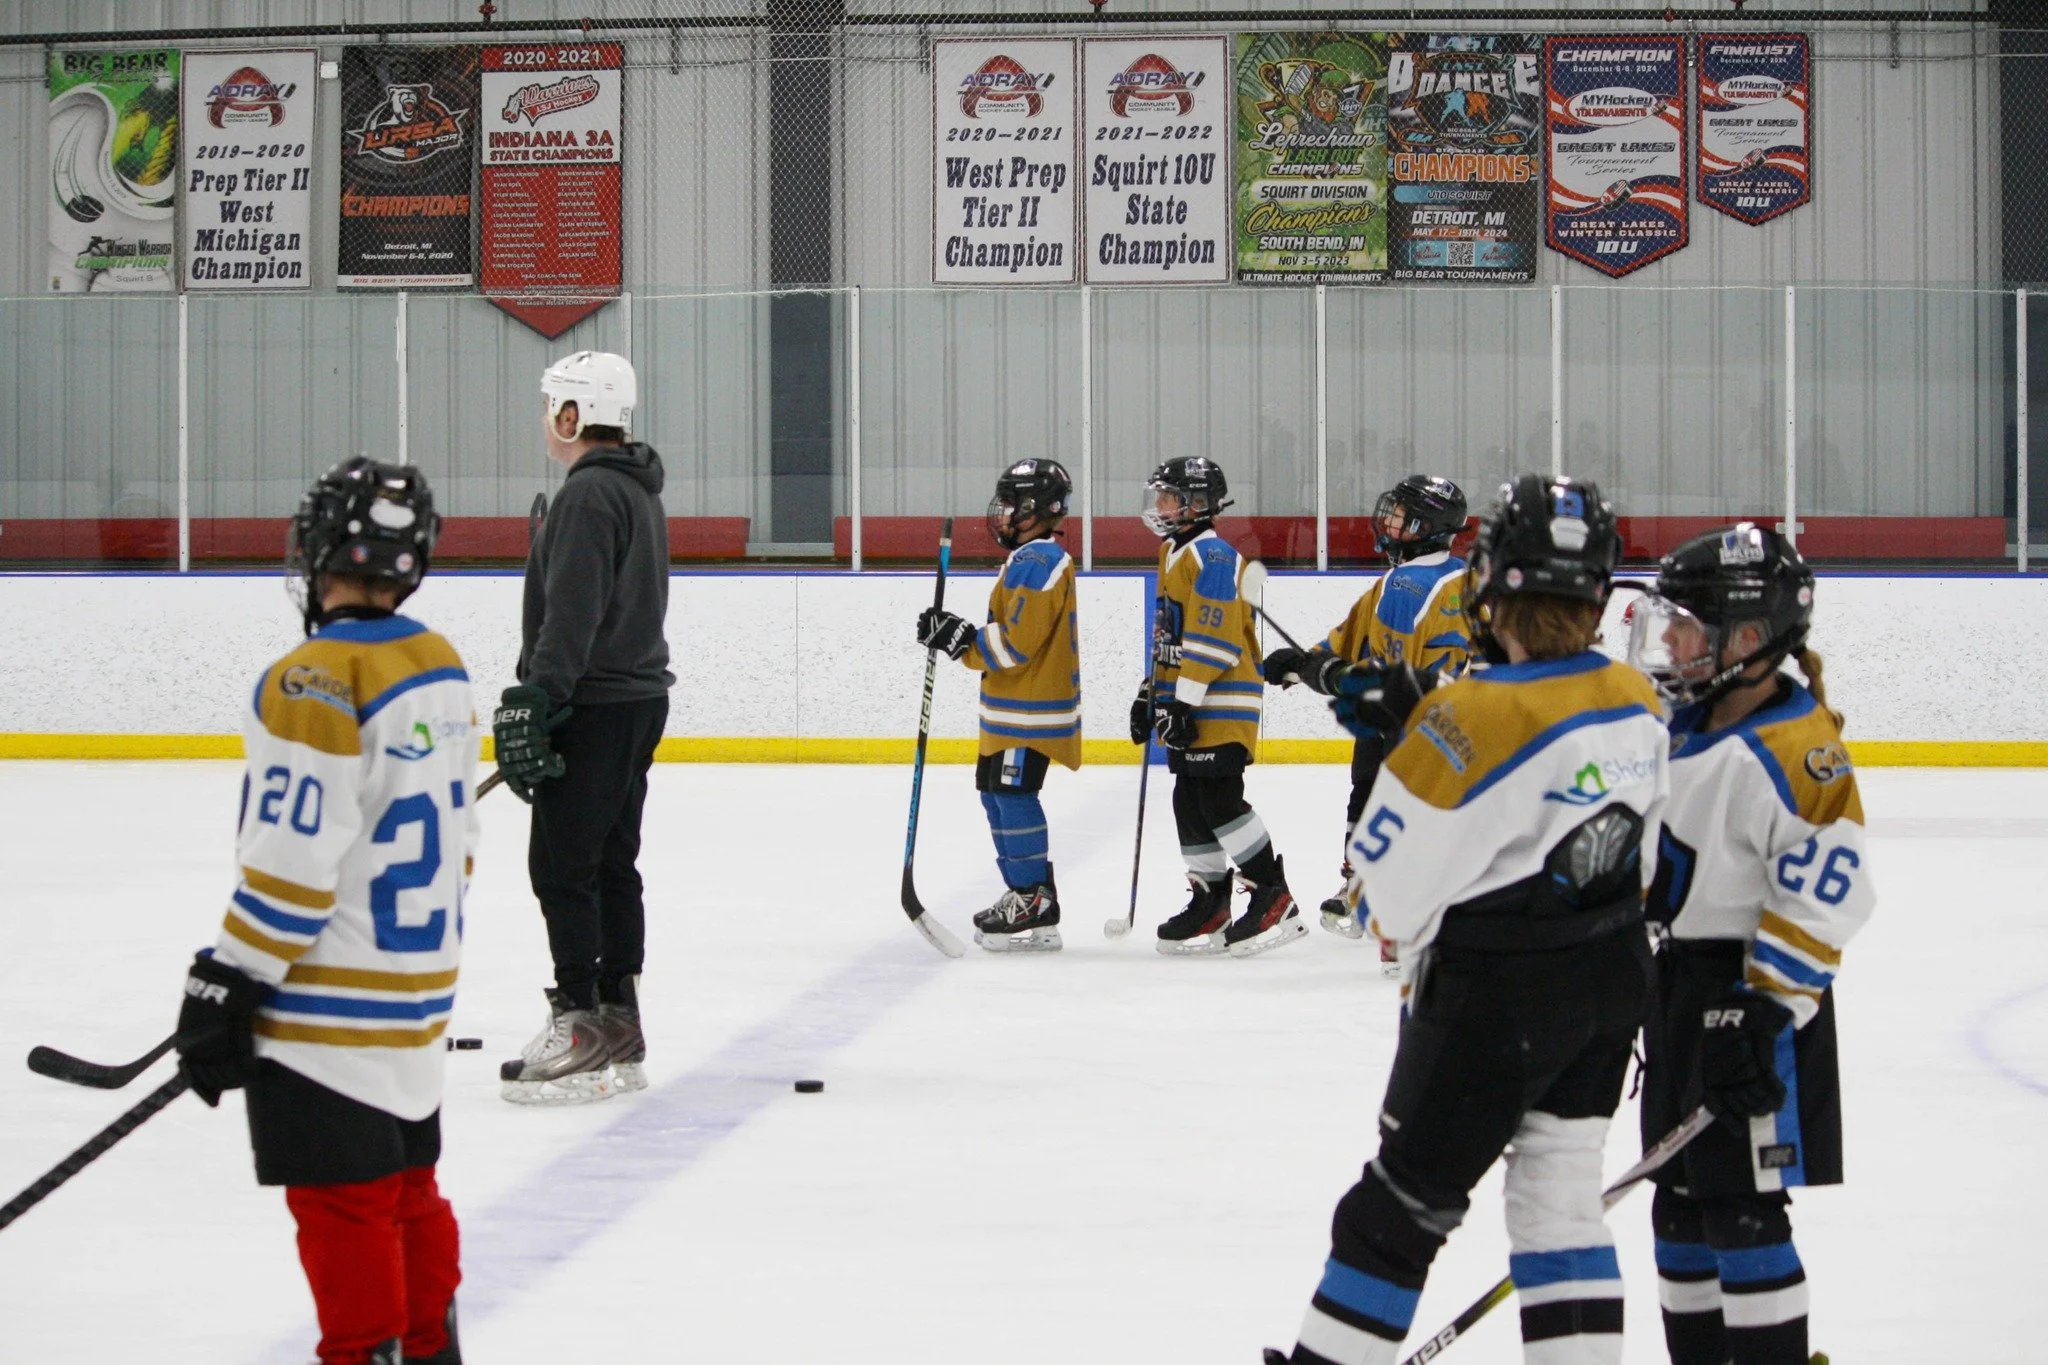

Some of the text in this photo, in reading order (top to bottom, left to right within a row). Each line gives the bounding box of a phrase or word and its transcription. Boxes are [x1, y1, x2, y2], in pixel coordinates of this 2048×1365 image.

[503, 51, 546, 65] 2020
[557, 49, 601, 64] 2021
[1556, 49, 1674, 62] CHAMPION
[1709, 45, 1797, 55] FINALIST
[64, 52, 168, 72] BIG BEAR
[520, 76, 595, 107] Warriors
[1416, 72, 1511, 100] DANCE
[1581, 95, 1653, 107] MYHockey
[1575, 107, 1648, 117] TOURNAMENTS
[1709, 118, 1798, 127] GREAT LAKES
[363, 119, 458, 149] URSA
[416, 134, 459, 147] MAJOR
[489, 130, 614, 148] INDIANA 3A
[1249, 122, 1377, 157] Leprechaun
[1714, 128, 1787, 138] Tournament
[1729, 136, 1771, 145] Series
[490, 148, 614, 162] STATE CHAMPIONS
[1557, 142, 1676, 153] GREAT LAKES
[1394, 153, 1531, 183] CHAMPIONS
[1567, 154, 1661, 166] Tournament
[945, 156, 1066, 193] West Prep
[1092, 153, 1216, 192] Squirt 10U
[1585, 163, 1637, 176] Series
[189, 167, 309, 196] Prep Tier II
[1261, 186, 1368, 199] SQUIRT DIVISION
[1427, 190, 1493, 201] U10 SQUIRT
[219, 200, 274, 223] West
[343, 195, 472, 217] CHAMPIONS
[962, 196, 1041, 228] Tier II
[1125, 193, 1188, 225] State
[1246, 199, 1376, 236] Champions
[1411, 211, 1507, 227] DETROIT, MI
[1622, 220, 1666, 228] LAKES
[1412, 228, 1433, 236] MAY
[1484, 229, 1508, 237] 2024
[1557, 228, 1678, 237] WINTER CLASSIC
[194, 228, 302, 255] Michigan
[1259, 236, 1365, 251] SOUTH BEND, IN
[945, 236, 1064, 273] Champion
[1099, 232, 1216, 270] Champion
[1279, 256, 1299, 265] NOV
[1321, 256, 1349, 265] 2023
[192, 256, 302, 283] Champion
[1243, 273, 1382, 282] ULTIMATE HOCKEY TOURNAMENTS
[1395, 269, 1528, 280] BIG BEAR TOURNAMENTS
[1197, 604, 1224, 628] 39
[258, 766, 323, 836] 20
[1777, 838, 1860, 905] 26
